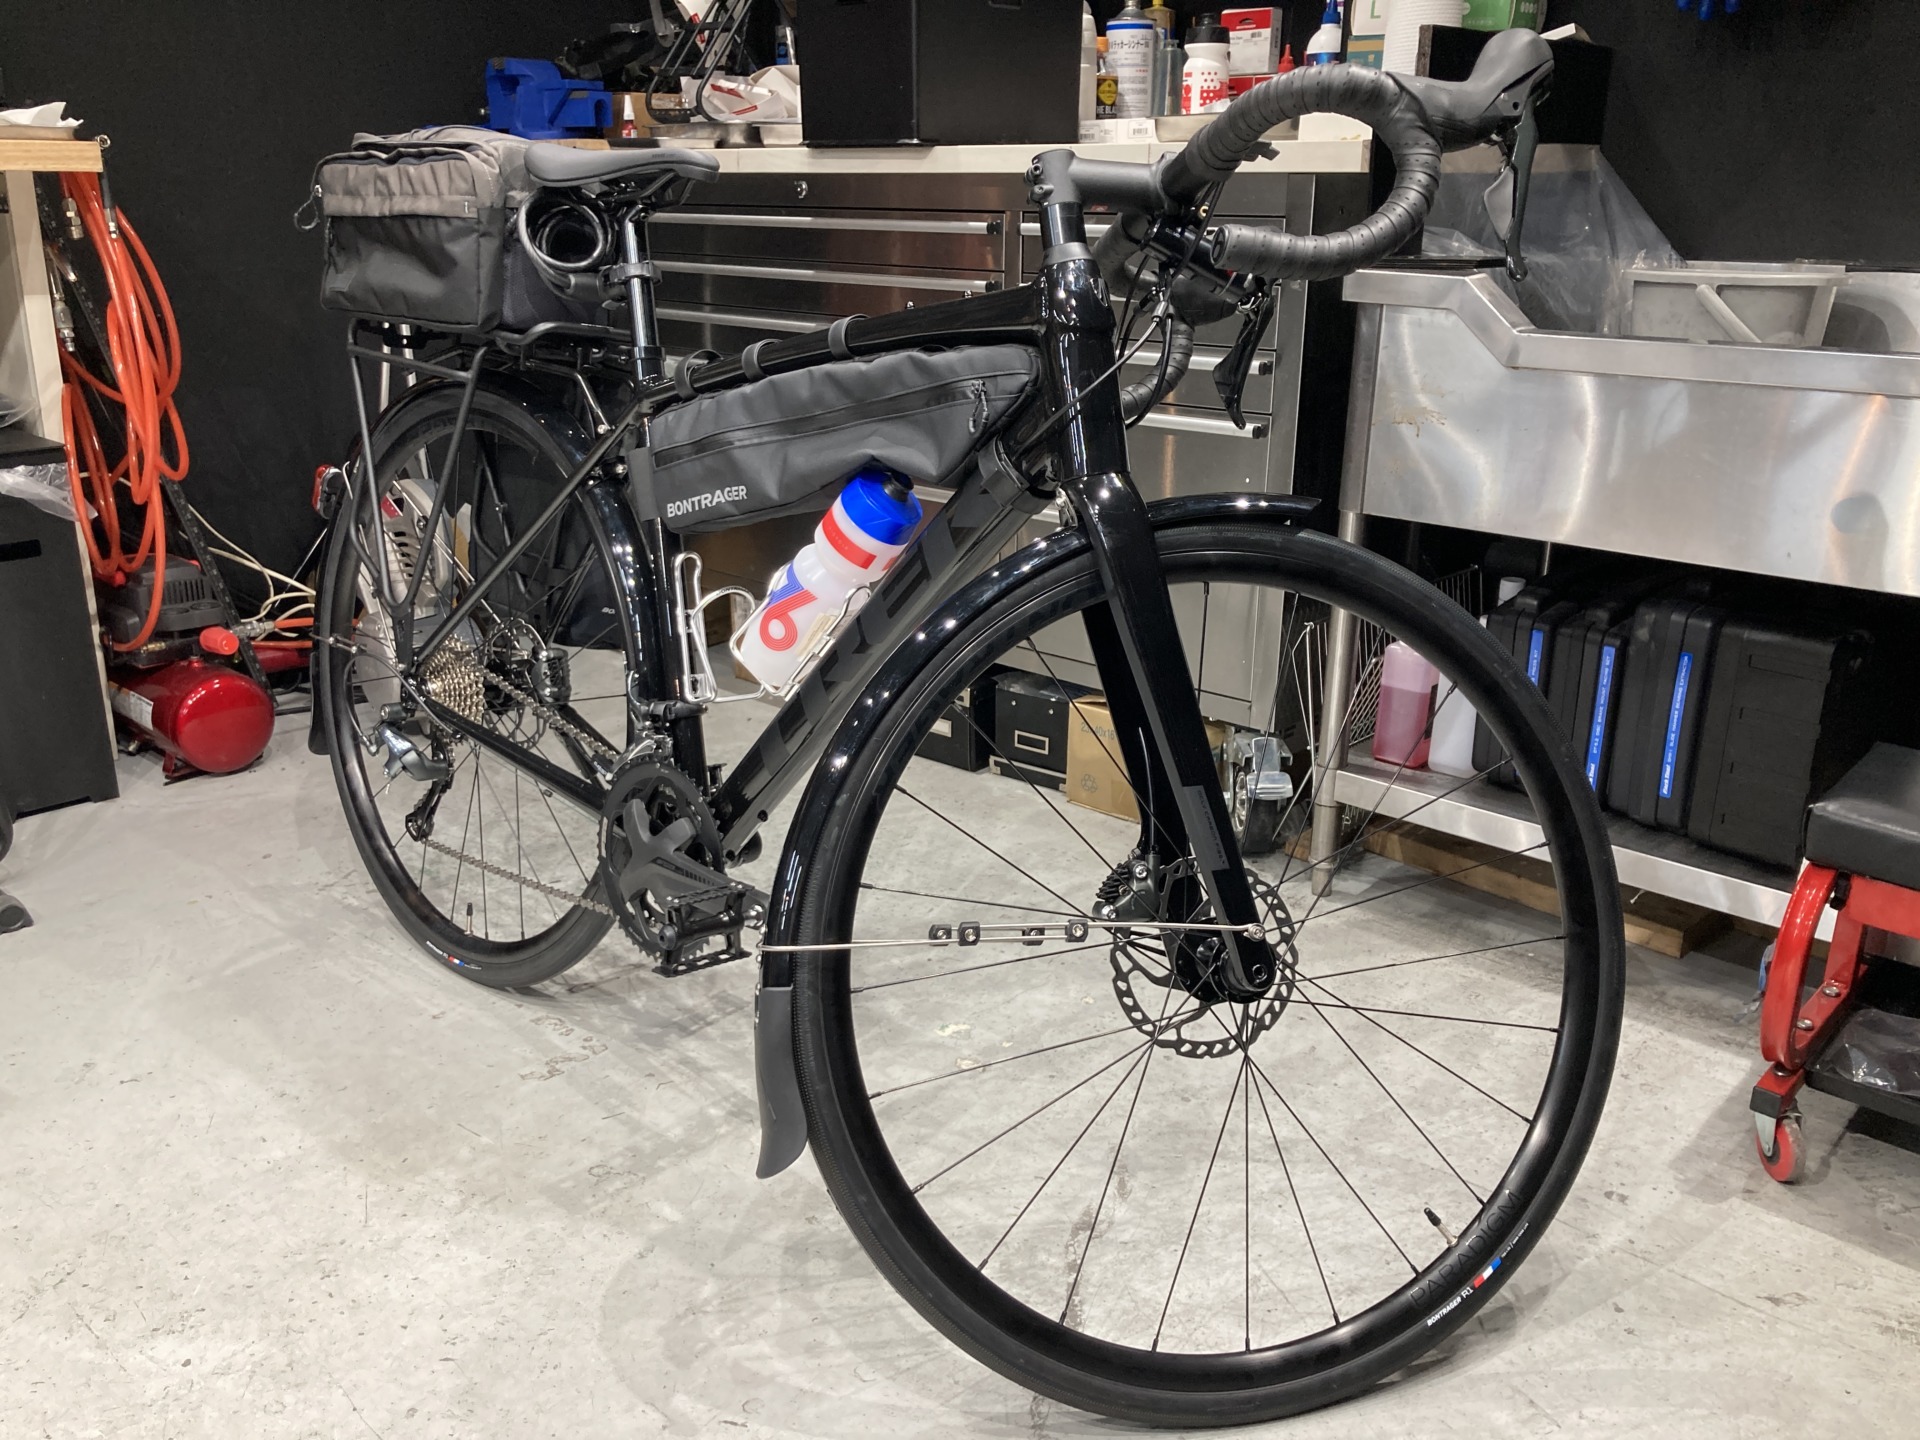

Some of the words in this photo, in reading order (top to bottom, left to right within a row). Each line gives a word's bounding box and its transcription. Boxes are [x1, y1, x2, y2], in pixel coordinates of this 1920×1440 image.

[667, 485, 748, 518] BONTRAGER
[1679, 655, 1689, 686] EXTRACTOR
[1408, 1189, 1521, 1308] PARADIGM
[1427, 1296, 1462, 1326] BONTRAGER
[1461, 1286, 1474, 1299] R1
